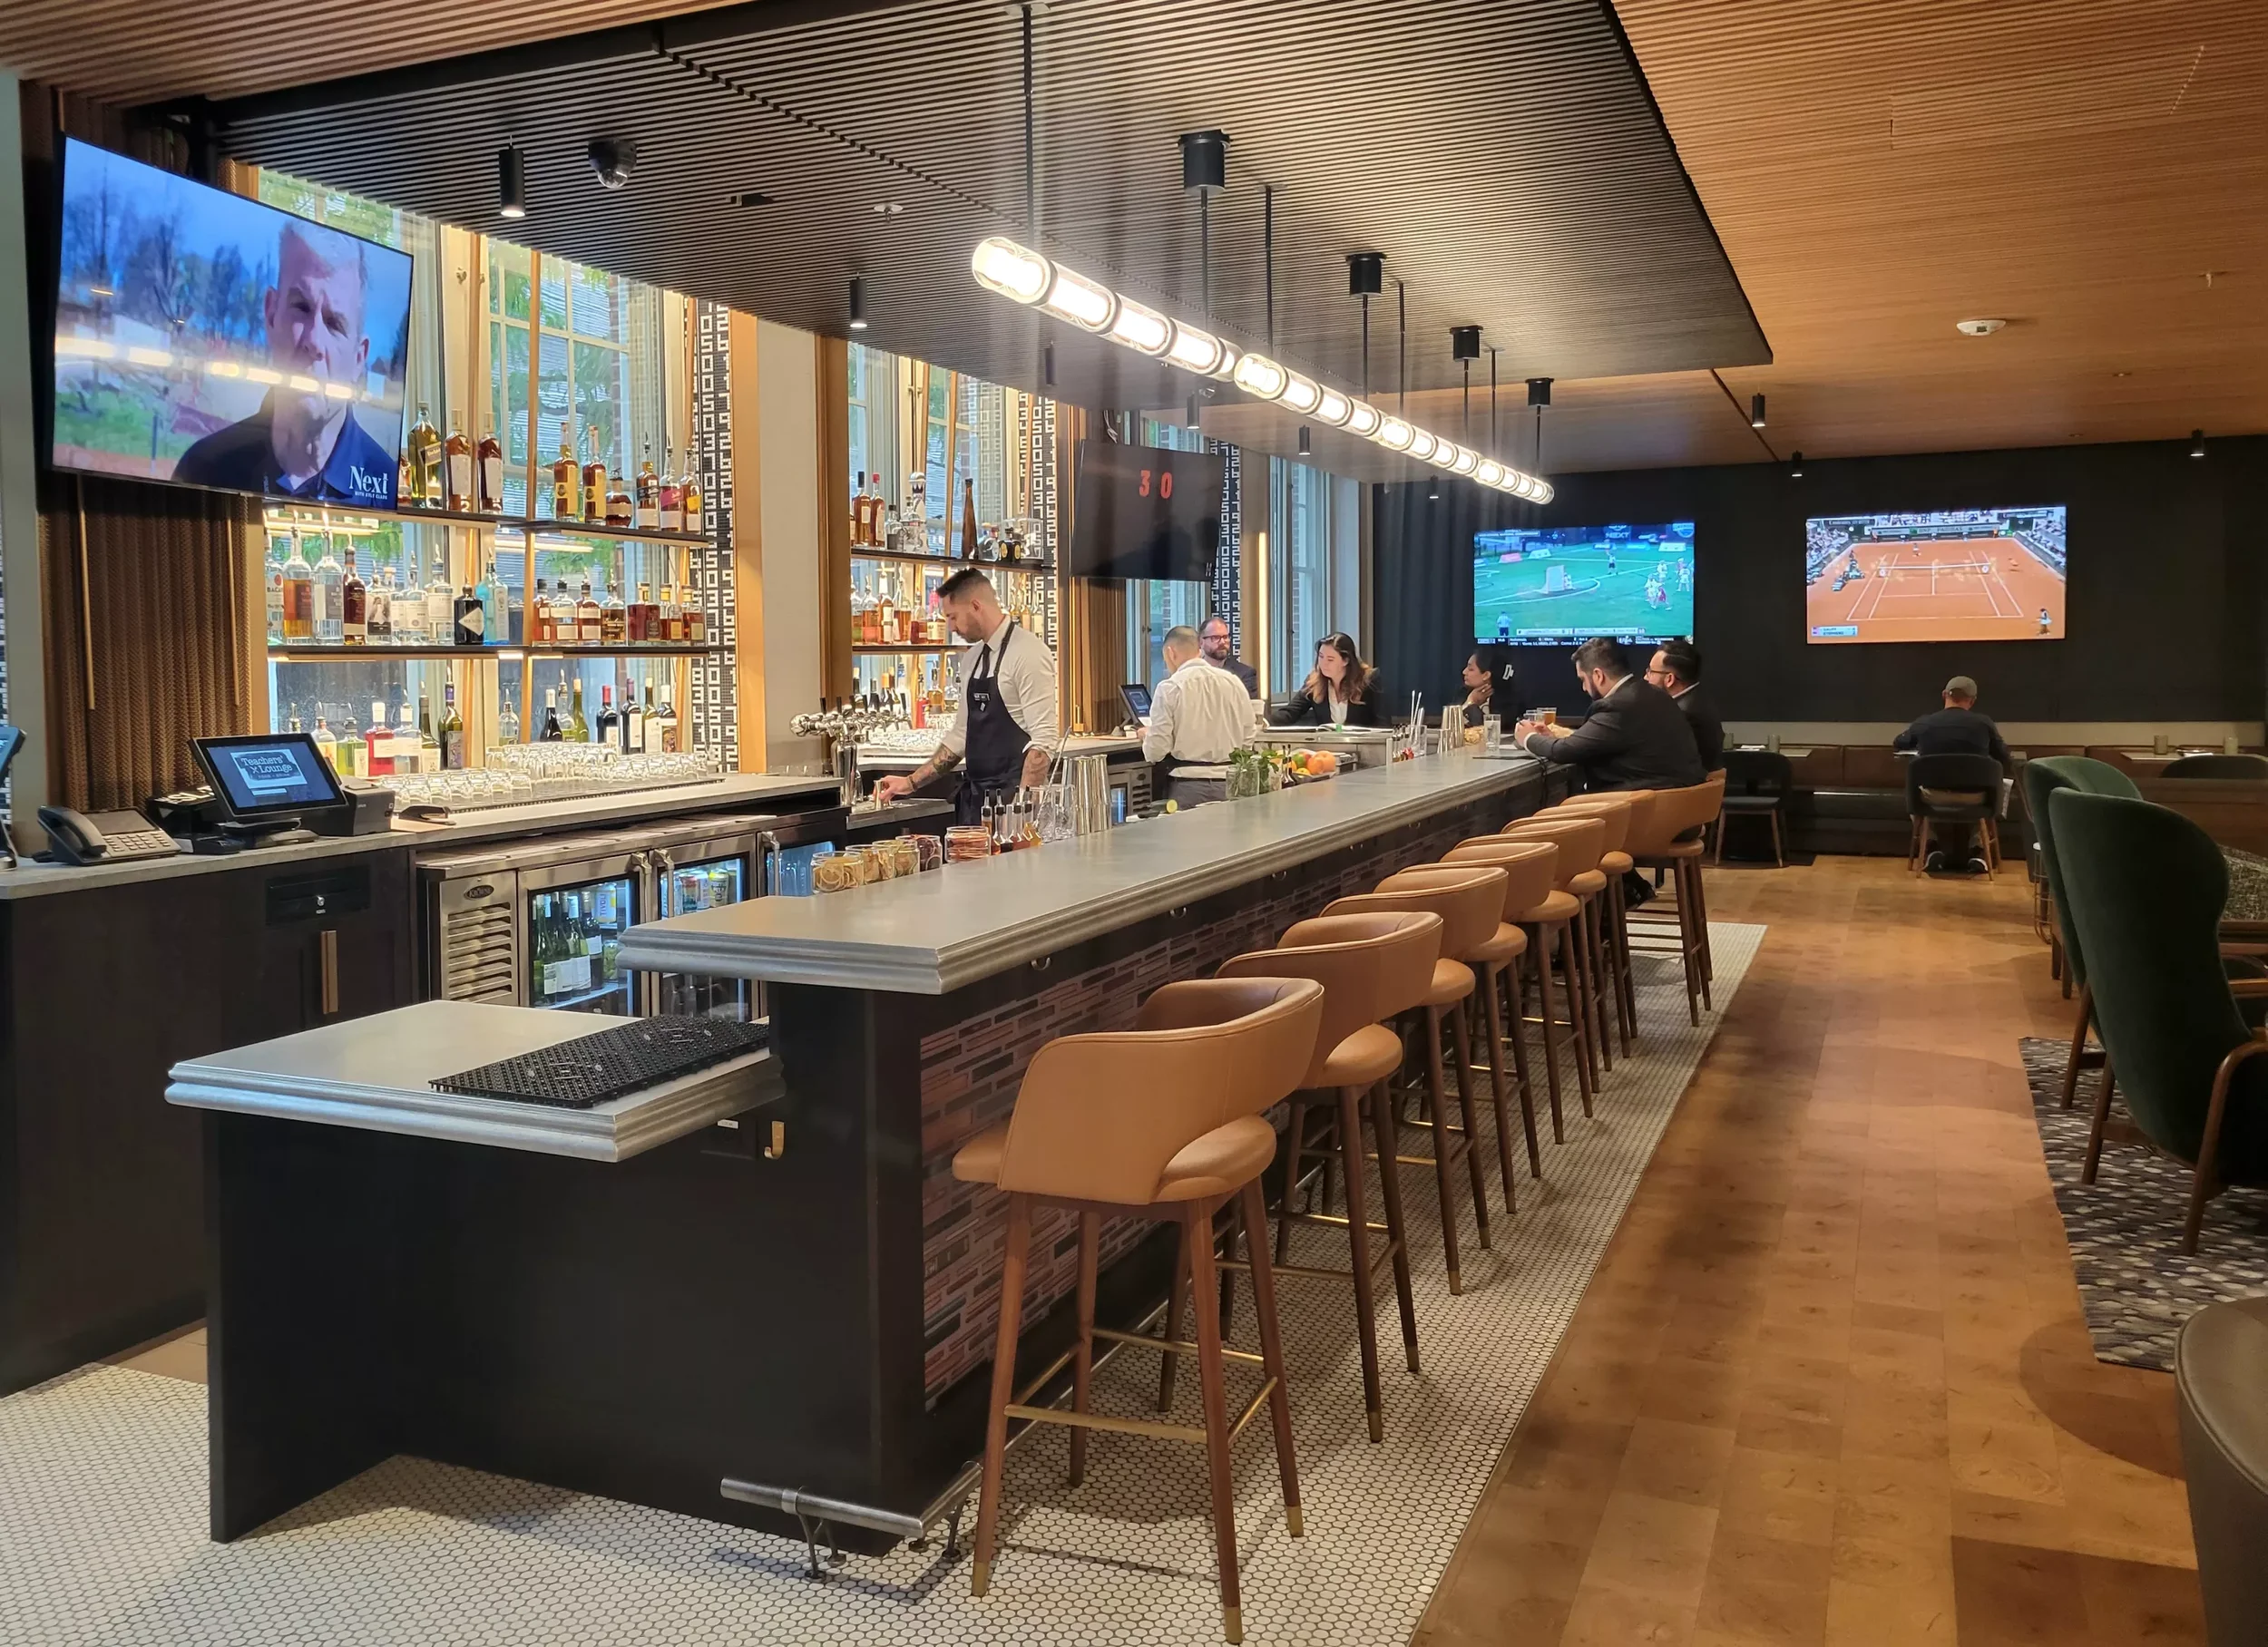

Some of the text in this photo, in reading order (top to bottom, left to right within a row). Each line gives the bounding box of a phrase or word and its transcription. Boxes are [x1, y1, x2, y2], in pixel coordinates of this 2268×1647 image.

[348, 465, 388, 494] Next
[259, 764, 293, 774] Lounge
[599, 893, 607, 916] TIVOLI
